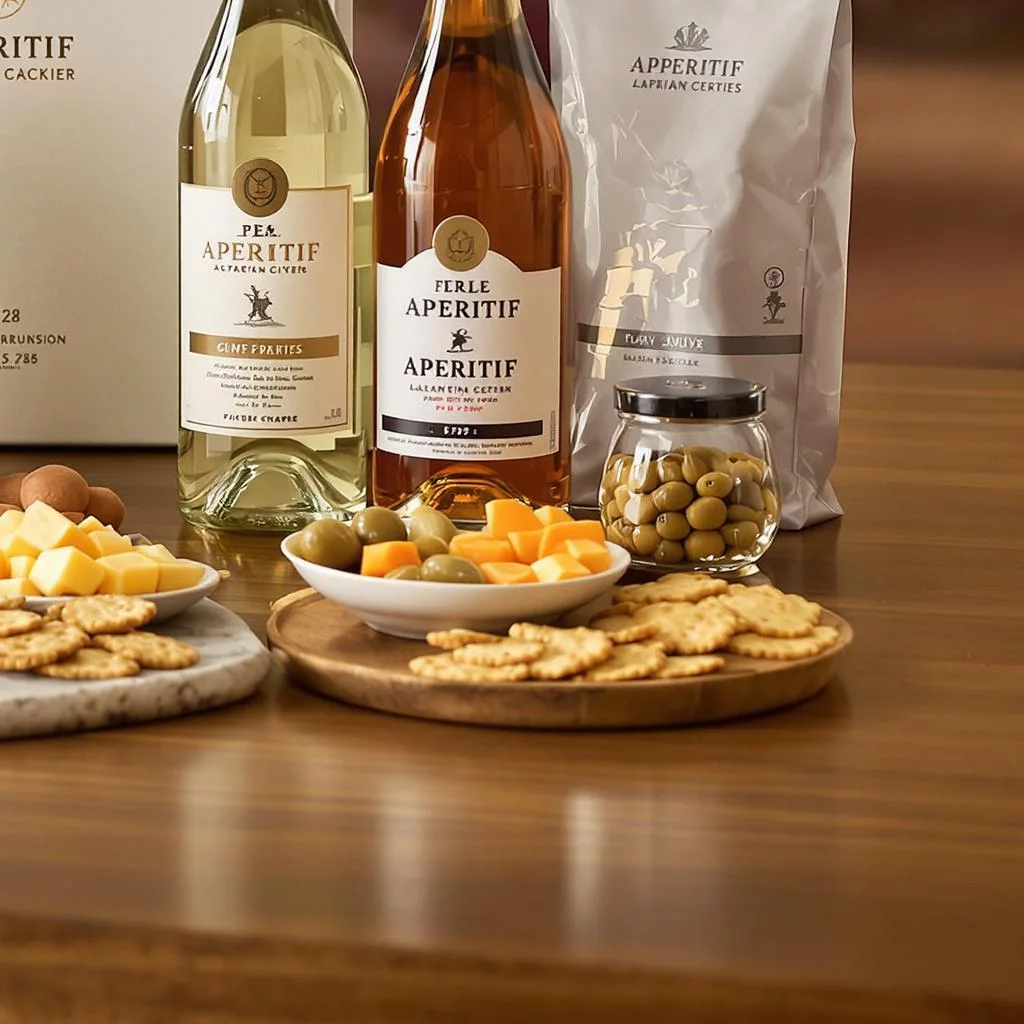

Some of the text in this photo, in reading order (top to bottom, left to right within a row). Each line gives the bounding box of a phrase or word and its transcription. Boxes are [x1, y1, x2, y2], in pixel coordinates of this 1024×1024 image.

[4, 68, 75, 81] CACKIER
[630, 56, 744, 77] APPERITIF
[202, 241, 320, 262] APERITIF
[406, 297, 520, 319] APERITIF
[403, 356, 518, 378] APERITIF
